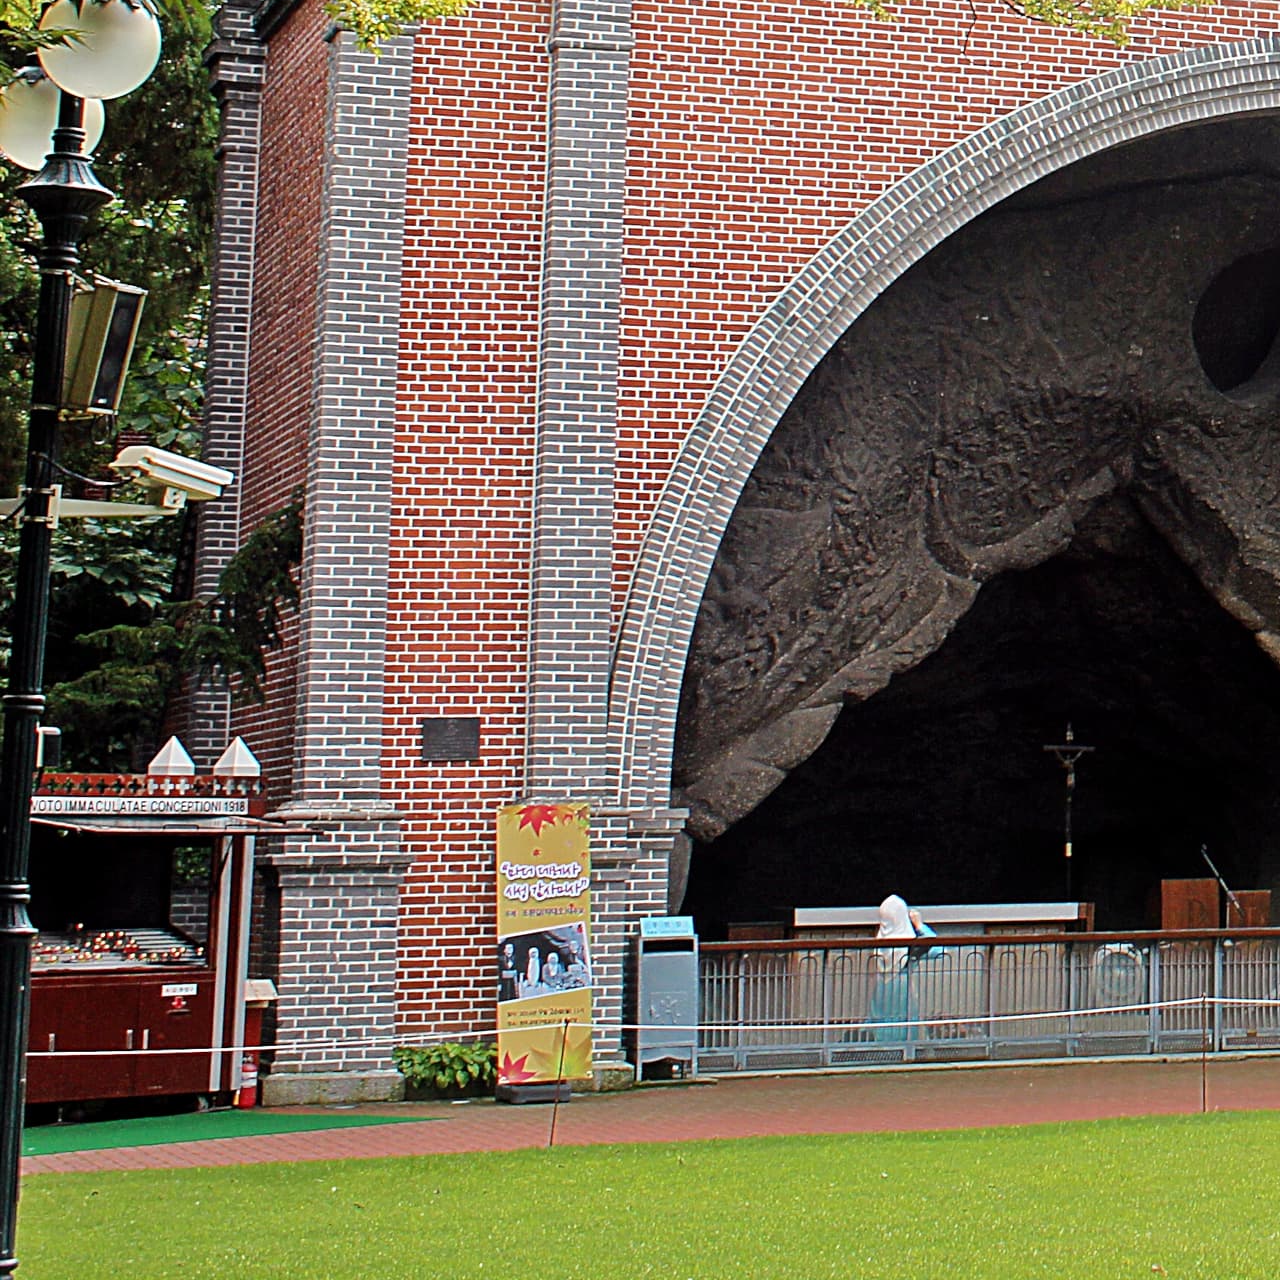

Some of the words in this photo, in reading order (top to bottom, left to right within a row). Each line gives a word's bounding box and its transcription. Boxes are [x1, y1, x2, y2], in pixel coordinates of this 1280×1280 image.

[65, 799, 147, 813] IMMACULATAE
[150, 800, 221, 813] CONCEPTIONI
[224, 800, 245, 813] 1918
